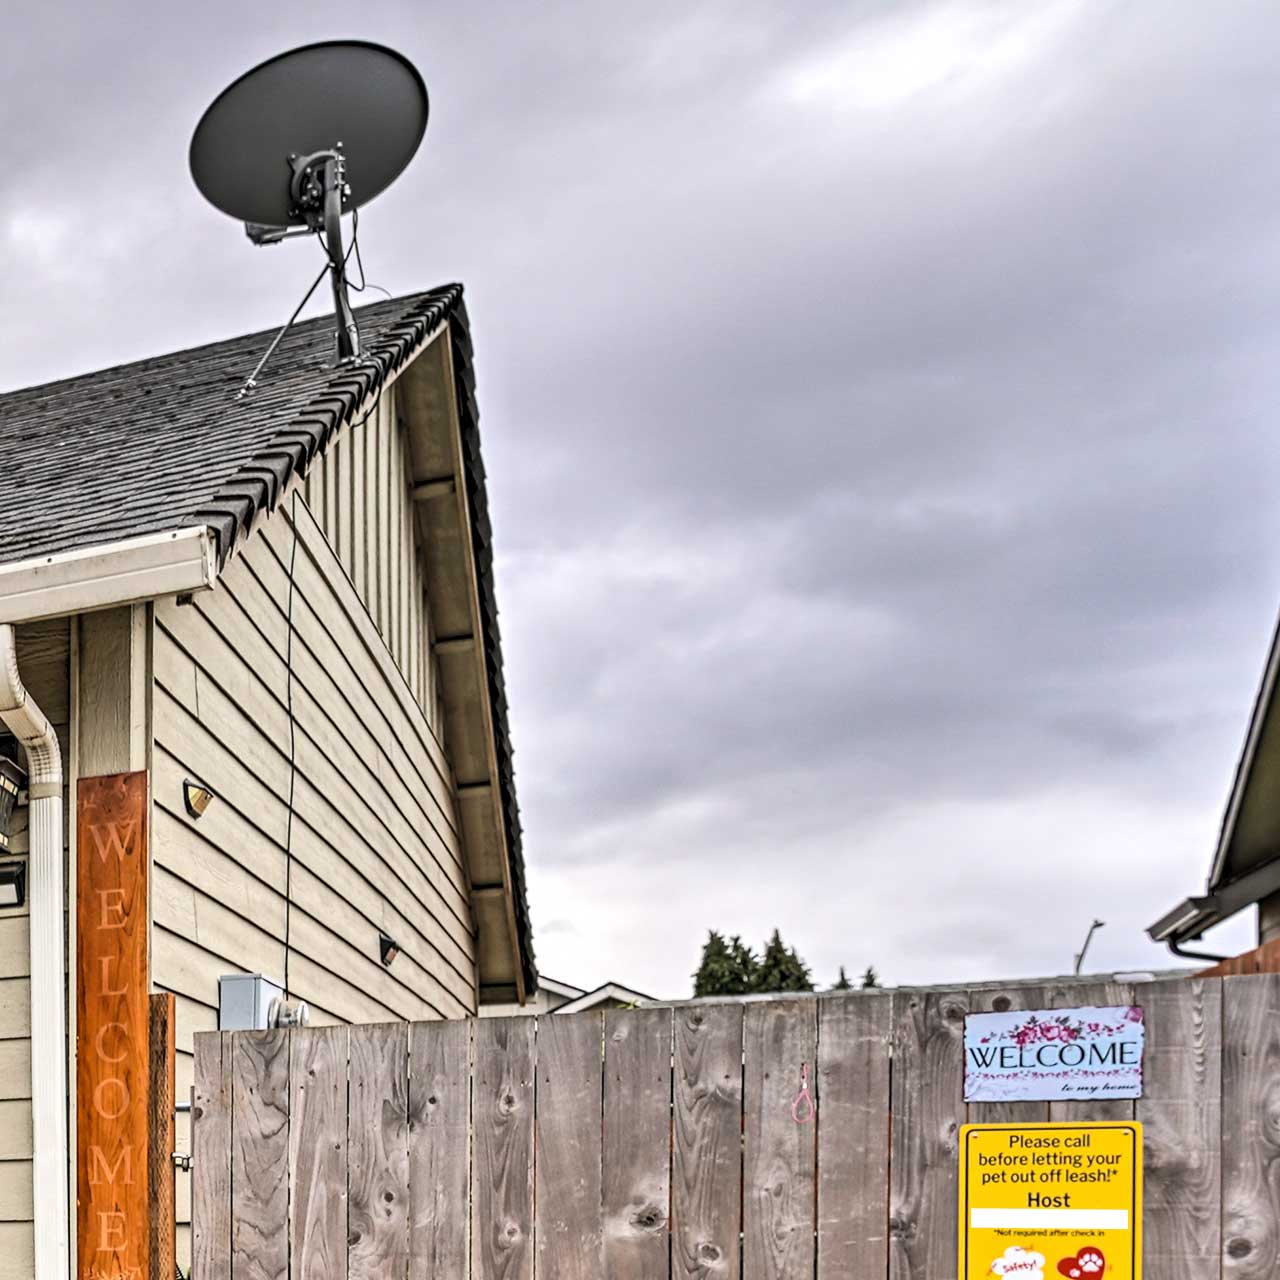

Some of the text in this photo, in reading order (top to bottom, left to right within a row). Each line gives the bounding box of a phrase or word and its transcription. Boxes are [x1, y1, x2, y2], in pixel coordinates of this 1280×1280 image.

[88, 823, 137, 1252] WELCOME
[969, 1041, 1138, 1069] WELCOME
[1061, 1083, 1137, 1095] to my home
[1009, 1134, 1090, 1148] Please call
[979, 1152, 1122, 1168] before letting your
[982, 1171, 1006, 1185] pet
[1010, 1171, 1036, 1183] out
[1040, 1169, 1062, 1183] off
[1028, 1192, 1071, 1208] Host
[1013, 1230, 1048, 1238] required
[1002, 1260, 1037, 1273] Safety!
